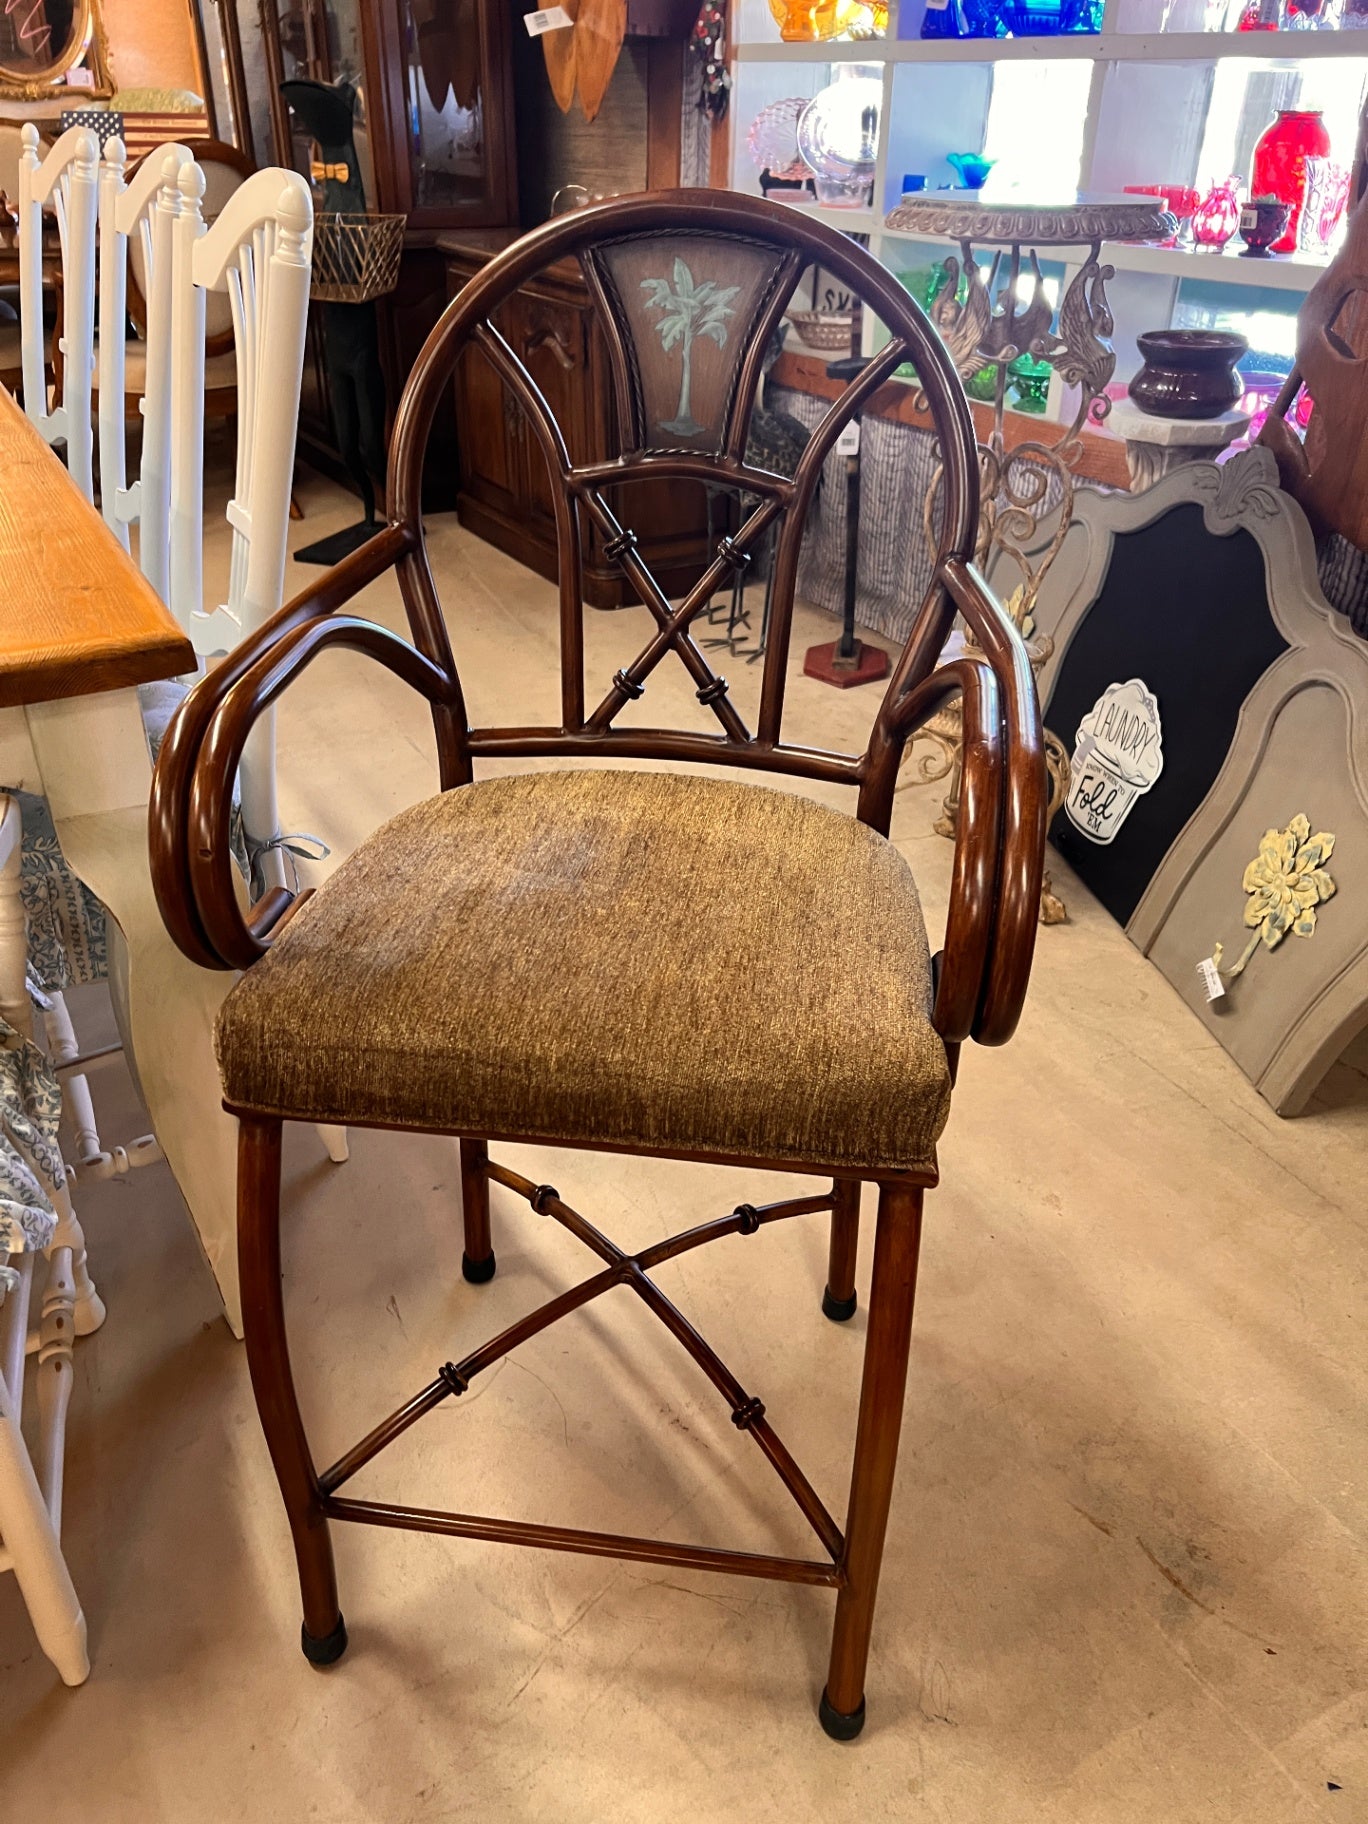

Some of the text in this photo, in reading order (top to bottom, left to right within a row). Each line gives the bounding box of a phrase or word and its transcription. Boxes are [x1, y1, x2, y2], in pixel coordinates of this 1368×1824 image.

[1093, 701, 1156, 765] LAUNDRY
[1072, 775, 1118, 820] Fold
[1102, 770, 1119, 787] WHEN
[1117, 785, 1126, 796] TO
